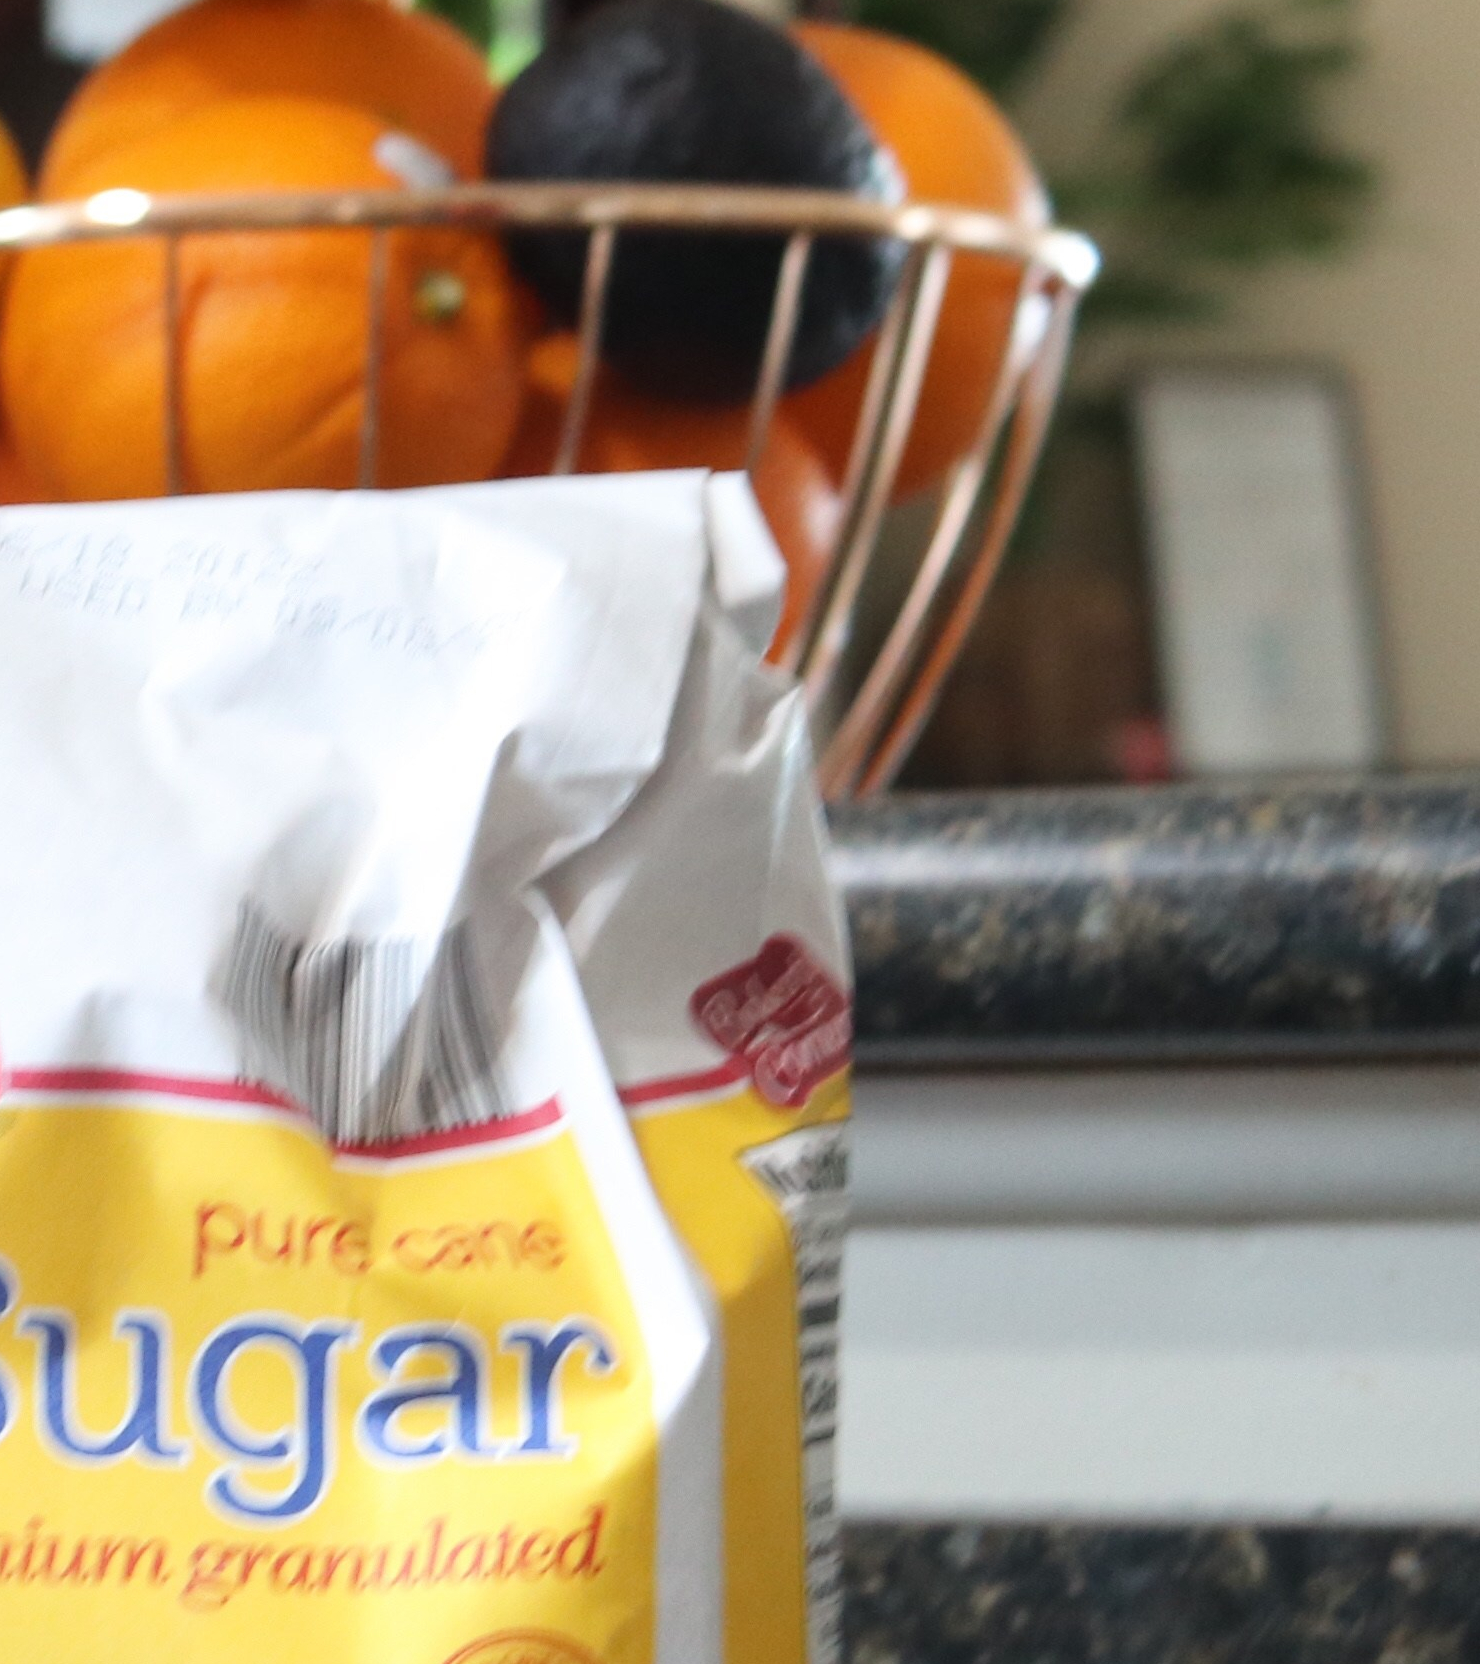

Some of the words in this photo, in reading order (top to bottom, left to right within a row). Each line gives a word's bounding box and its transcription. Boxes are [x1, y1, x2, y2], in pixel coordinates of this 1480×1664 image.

[190, 1200, 371, 1280] pure
[390, 1216, 566, 1276] cane
[177, 1501, 607, 1614] granulated
